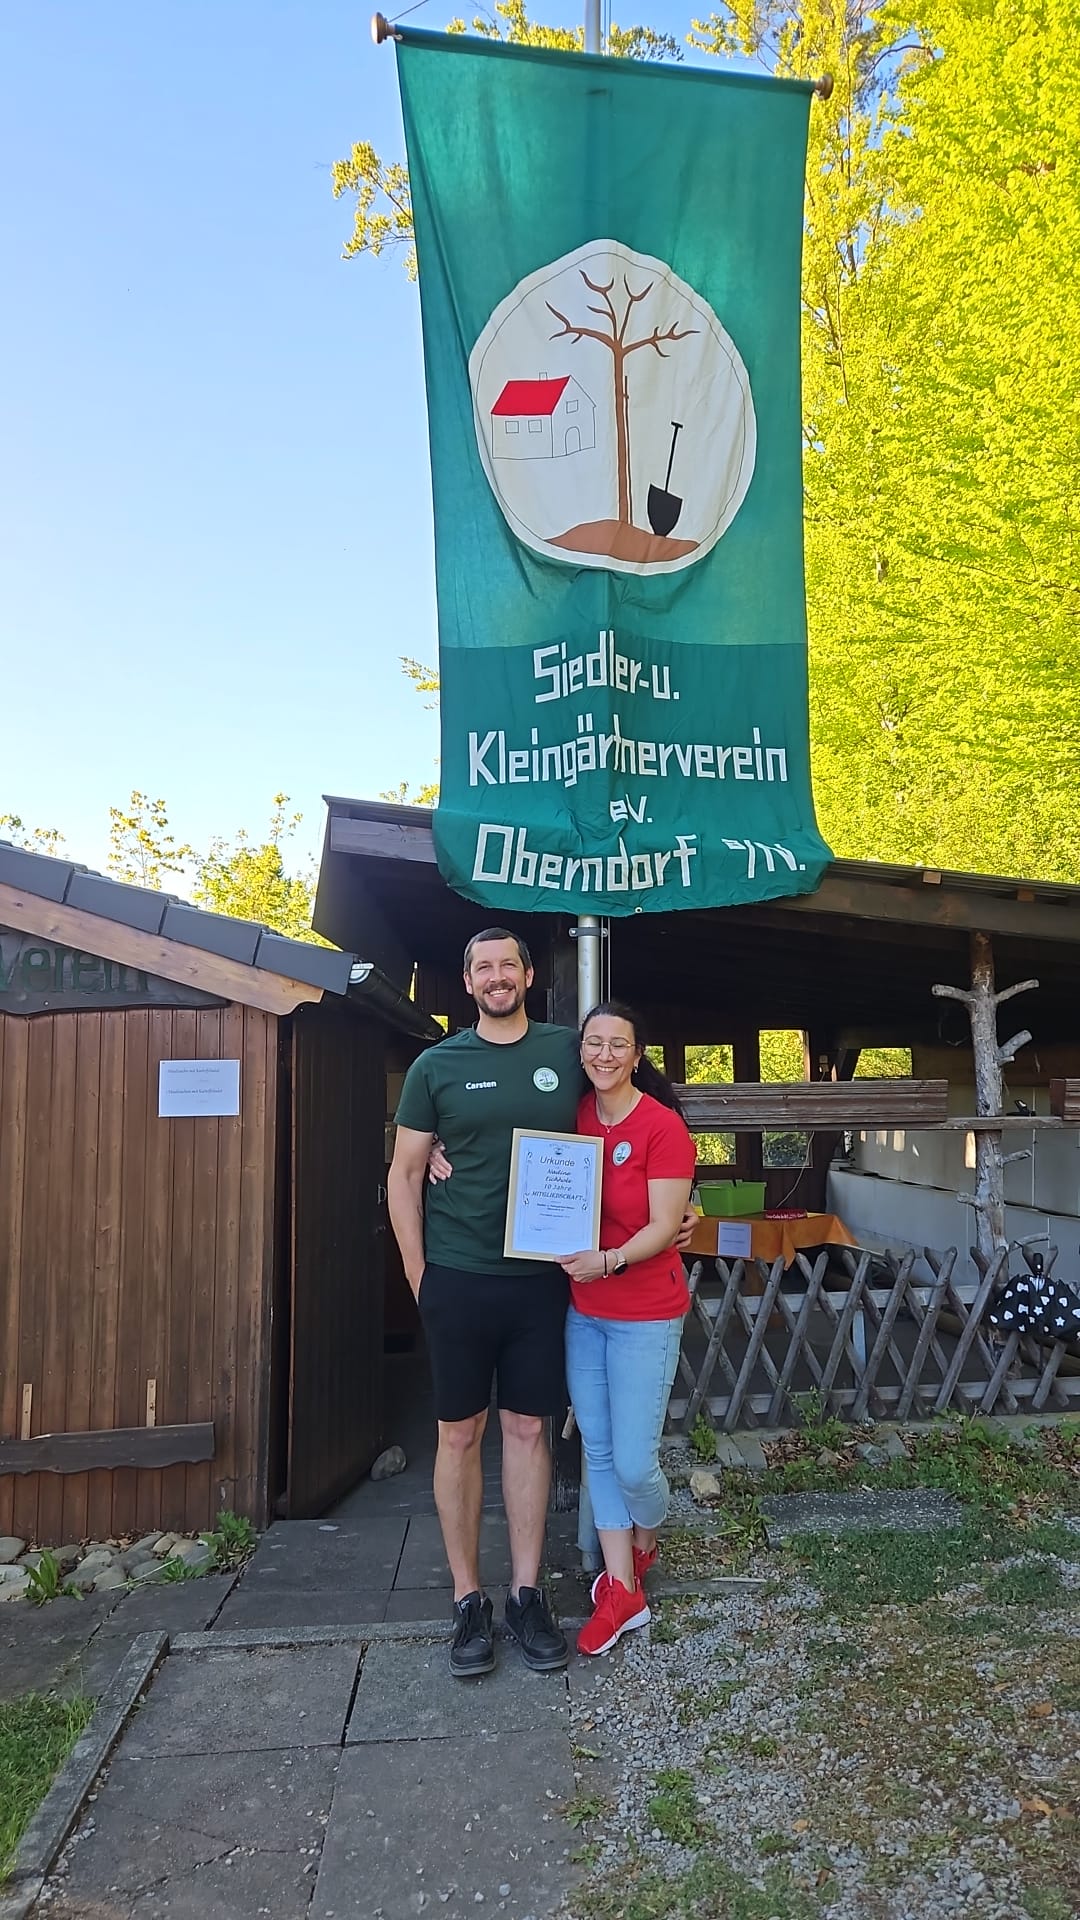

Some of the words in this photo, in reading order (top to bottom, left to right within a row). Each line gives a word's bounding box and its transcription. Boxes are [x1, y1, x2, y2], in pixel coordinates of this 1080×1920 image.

[468, 713, 788, 788] Kleingärtnerverein
[472, 823, 697, 892] Oberndorf
[465, 1080, 497, 1090] Carsten
[539, 1155, 575, 1167] Urkunde
[553, 1184, 572, 1192] Jahre
[531, 1191, 583, 1202] MITGLIEDSCHAFT
